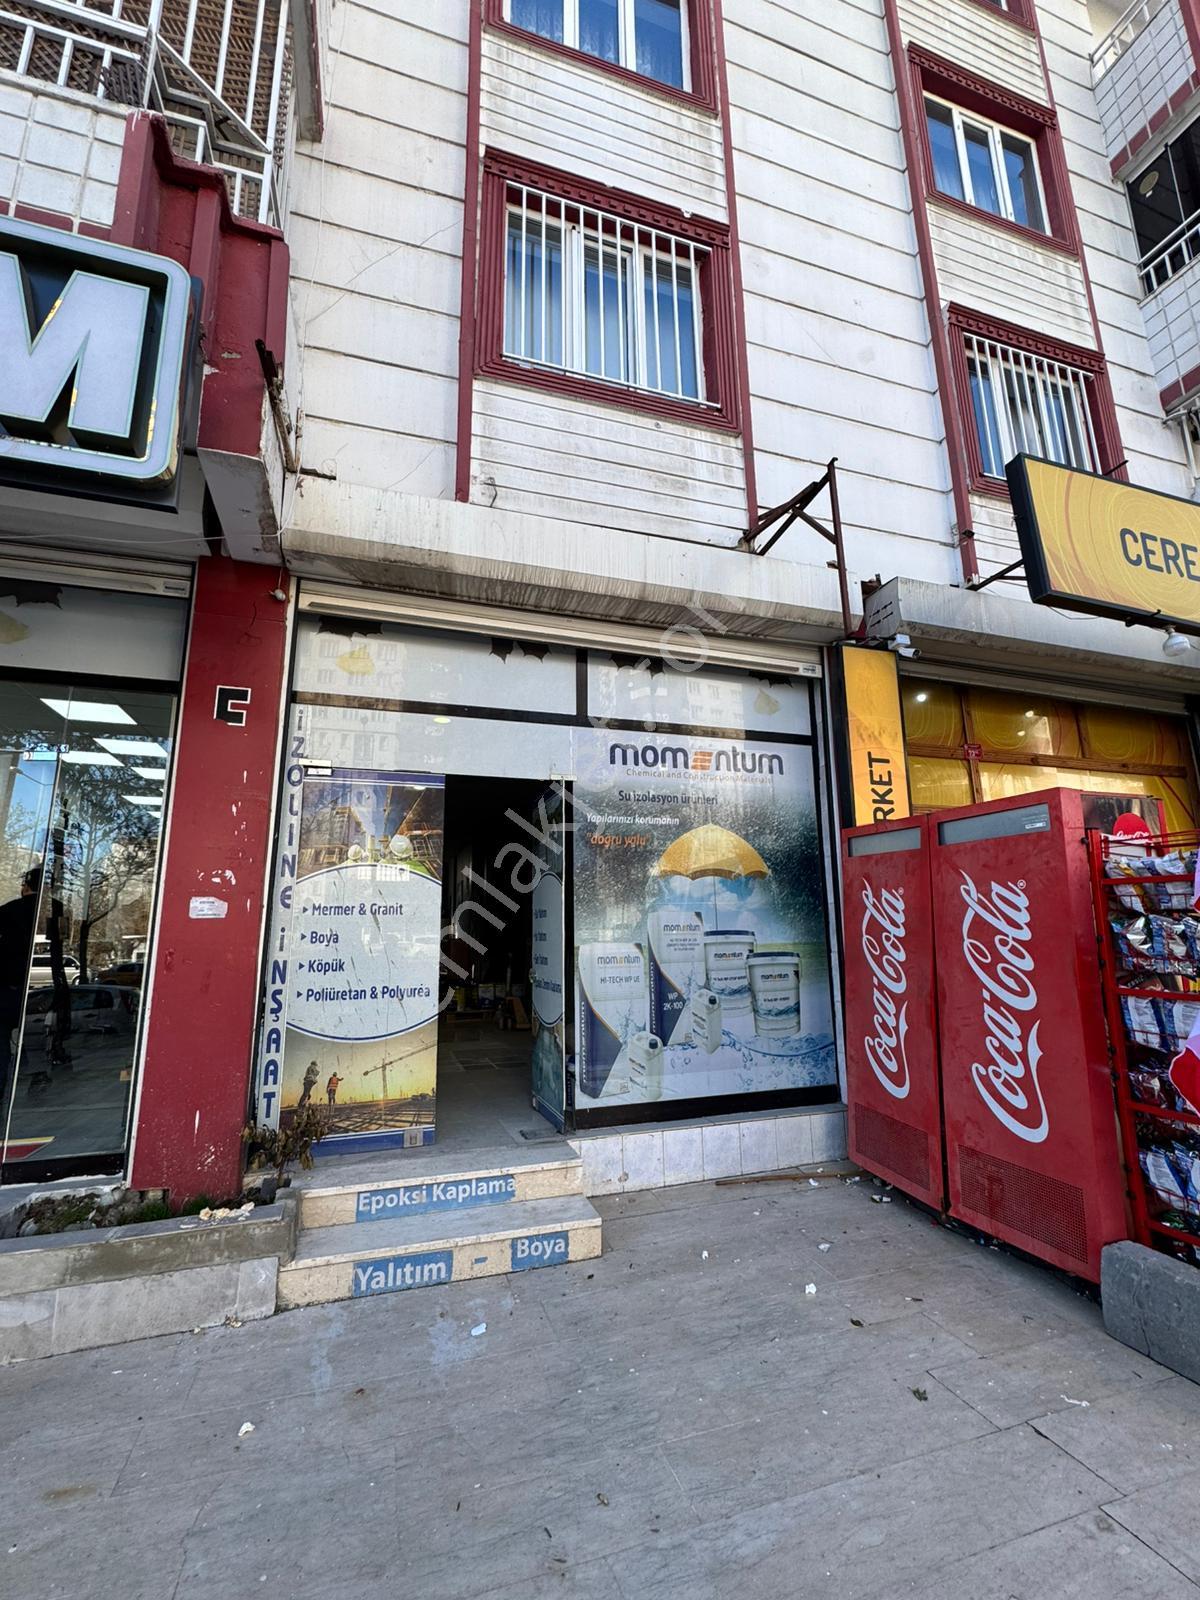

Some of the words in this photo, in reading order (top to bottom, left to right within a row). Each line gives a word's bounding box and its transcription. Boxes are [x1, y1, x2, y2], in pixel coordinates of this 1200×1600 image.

[1120, 528, 1200, 581] CERE
[609, 743, 784, 775] momentum
[626, 769, 665, 778] Chemical
[618, 791, 631, 801] Su
[632, 791, 679, 804] izolasyon
[681, 793, 718, 805] ürünleri
[312, 903, 356, 916] Mermer
[358, 903, 367, 916] &
[370, 902, 404, 916] Granit
[310, 931, 339, 947] Boya
[308, 959, 345, 975] Köpük
[597, 956, 641, 965] momentum
[600, 976, 624, 984] HI-TECH
[306, 988, 367, 1002] Poliüretan
[370, 986, 378, 999] &
[358, 1186, 427, 1214] Epoksi
[432, 1177, 516, 1203] Kaplama
[355, 1261, 446, 1292] Yalıtım
[516, 1238, 566, 1260] Boya
